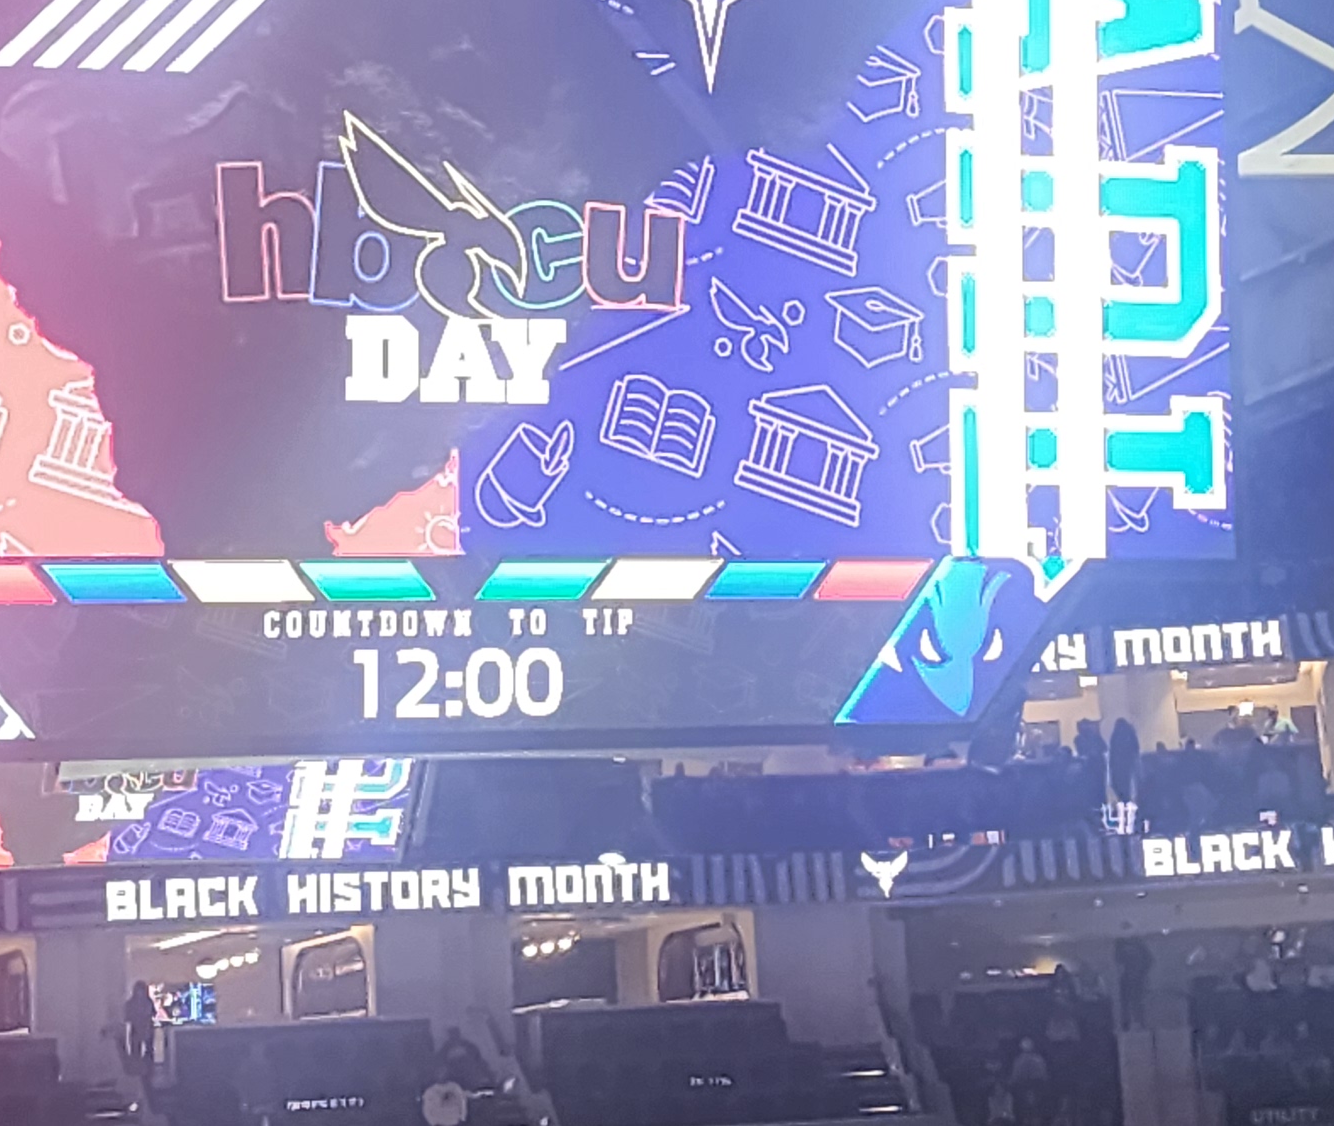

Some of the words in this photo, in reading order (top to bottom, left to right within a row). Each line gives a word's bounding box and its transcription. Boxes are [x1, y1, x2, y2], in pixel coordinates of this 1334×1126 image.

[344, 314, 567, 405] DAY
[263, 608, 472, 639] COUNTDOWN
[508, 608, 547, 636] TO
[582, 608, 633, 636] TIP
[1113, 620, 1283, 667] MONTH
[353, 647, 564, 719] 12:00
[1142, 830, 1296, 877] BLACK
[105, 875, 259, 922] BLACK
[287, 867, 480, 914] HISTORY
[508, 862, 670, 906] MONTH
